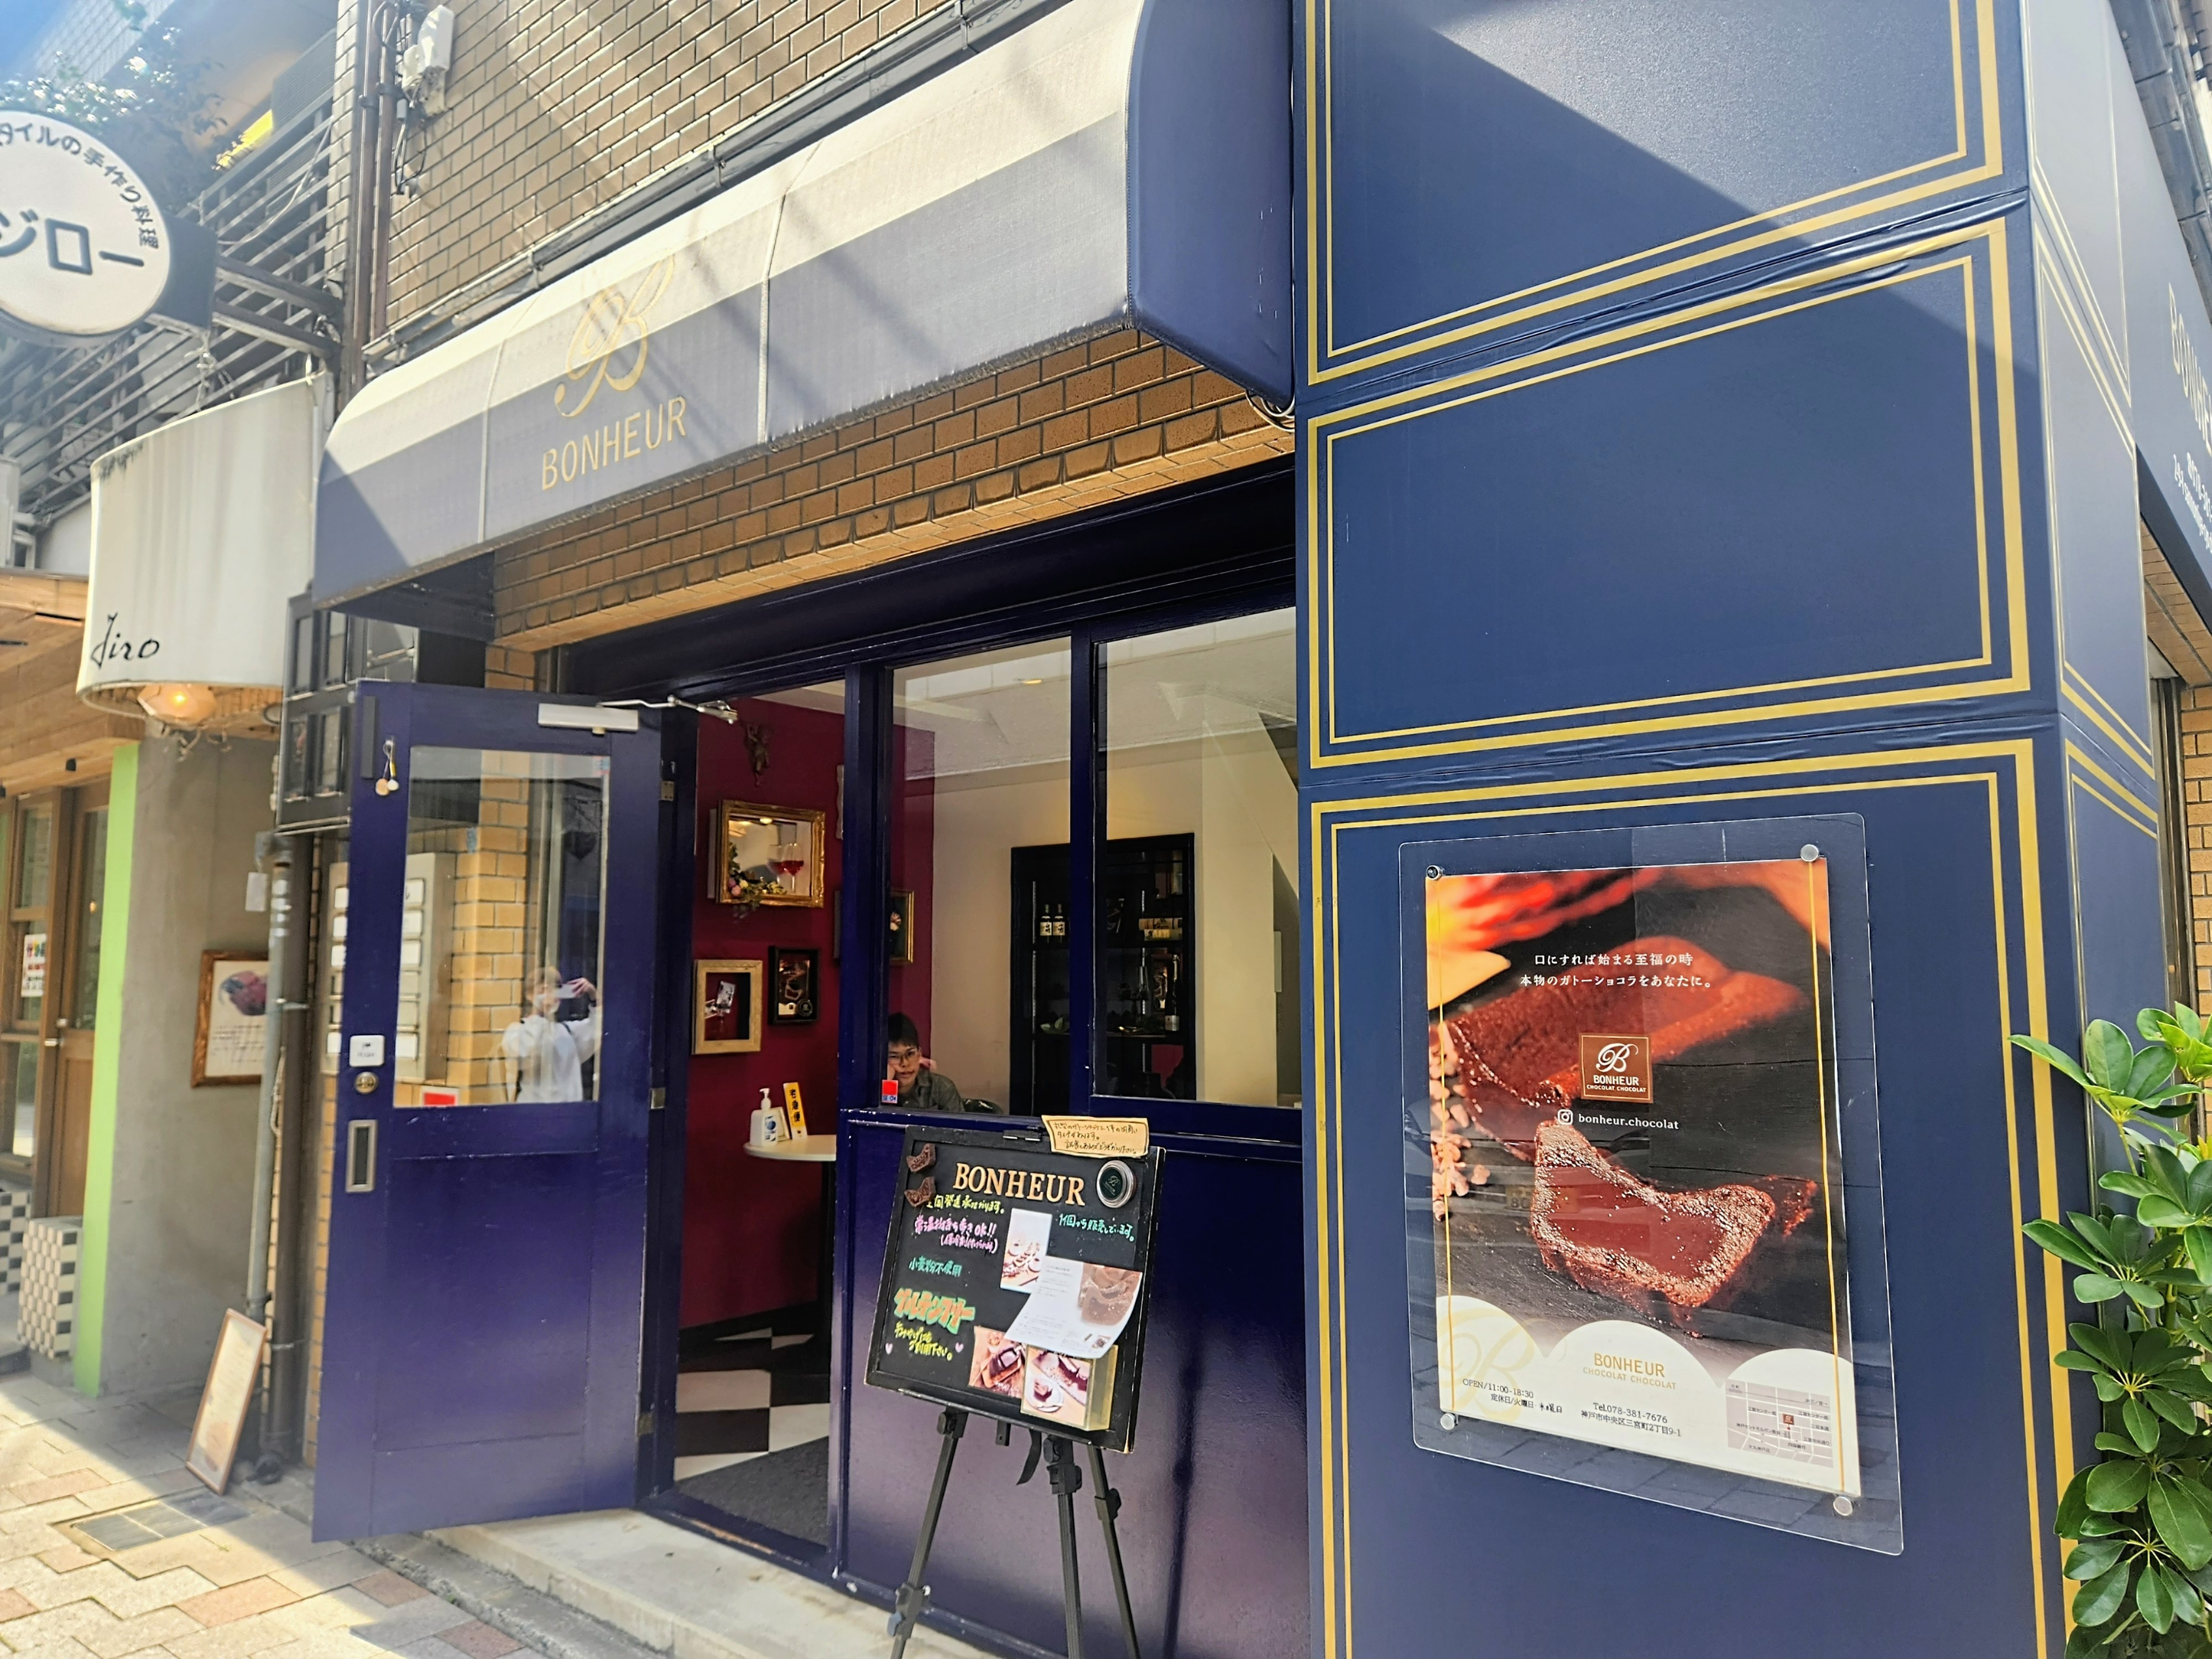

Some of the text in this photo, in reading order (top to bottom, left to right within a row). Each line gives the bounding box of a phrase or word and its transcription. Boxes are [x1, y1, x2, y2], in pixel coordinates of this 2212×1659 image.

[0, 123, 159, 249] タイルの手作り料理
[0, 209, 144, 275] ジロー
[542, 395, 686, 490] BONHEUR
[91, 612, 159, 670] Jiro
[1535, 953, 1693, 966] 口にすれば始まる至福の時
[1520, 974, 1710, 988] 本物のガトーショコラをあなたに。
[1595, 1043, 1639, 1072] B
[1593, 1074, 1639, 1086] BONHEUR
[1579, 1113, 1679, 1129] bonheur.chocolat
[953, 1162, 1085, 1206] BONHEUR
[909, 1255, 962, 1277] 小麦粉不使用
[894, 1287, 975, 1334] グルテンフリー
[1594, 1353, 1665, 1378] BONHEUR
[1463, 1378, 1533, 1399] OPEN/11:00-18:30
[1583, 1367, 1677, 1390] CHOCOLAT CHOCOLAT
[1581, 1410, 1681, 1437] 神戸市中央区三宮町2丁目9-1
[1593, 1402, 1668, 1423] Tel.078-381-7676
